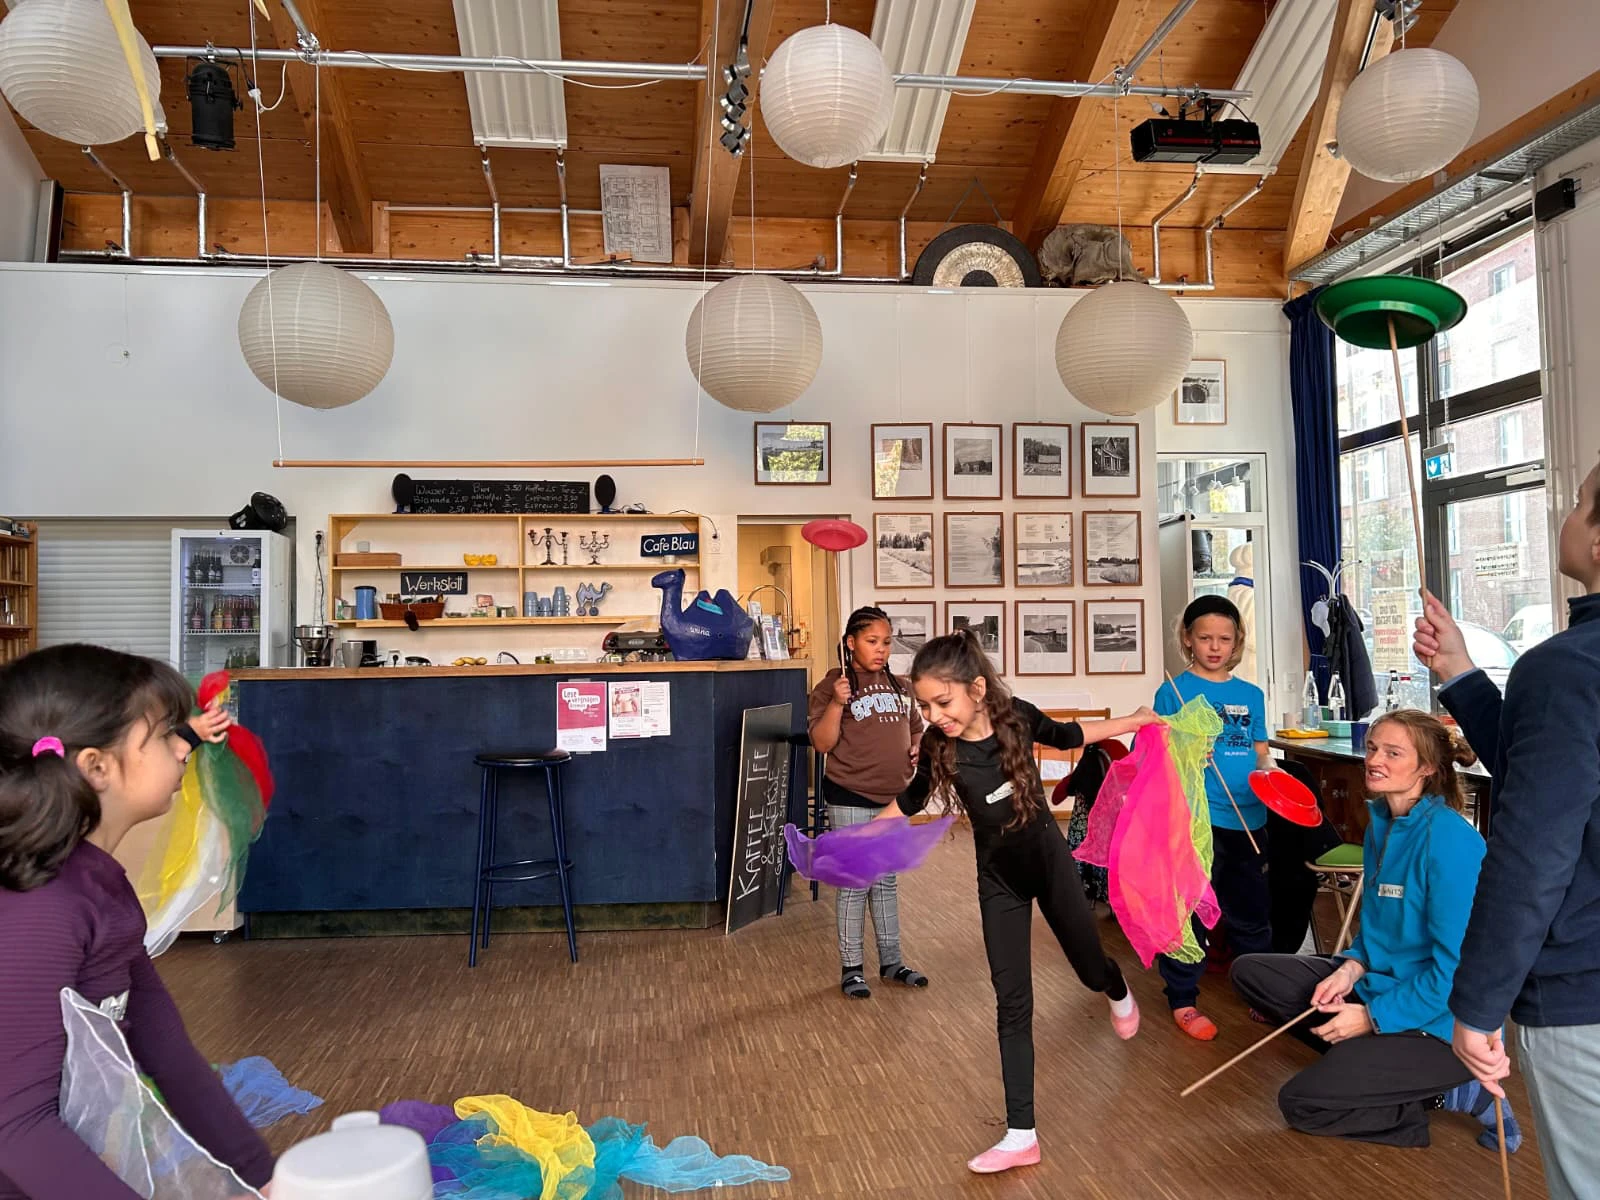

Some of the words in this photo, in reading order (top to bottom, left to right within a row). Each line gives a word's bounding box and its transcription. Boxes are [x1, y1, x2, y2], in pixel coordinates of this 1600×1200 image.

[643, 537, 670, 554] Cafe
[671, 536, 695, 551] Blau
[745, 745, 770, 800] TEE
[736, 806, 764, 900] KAFFEE
